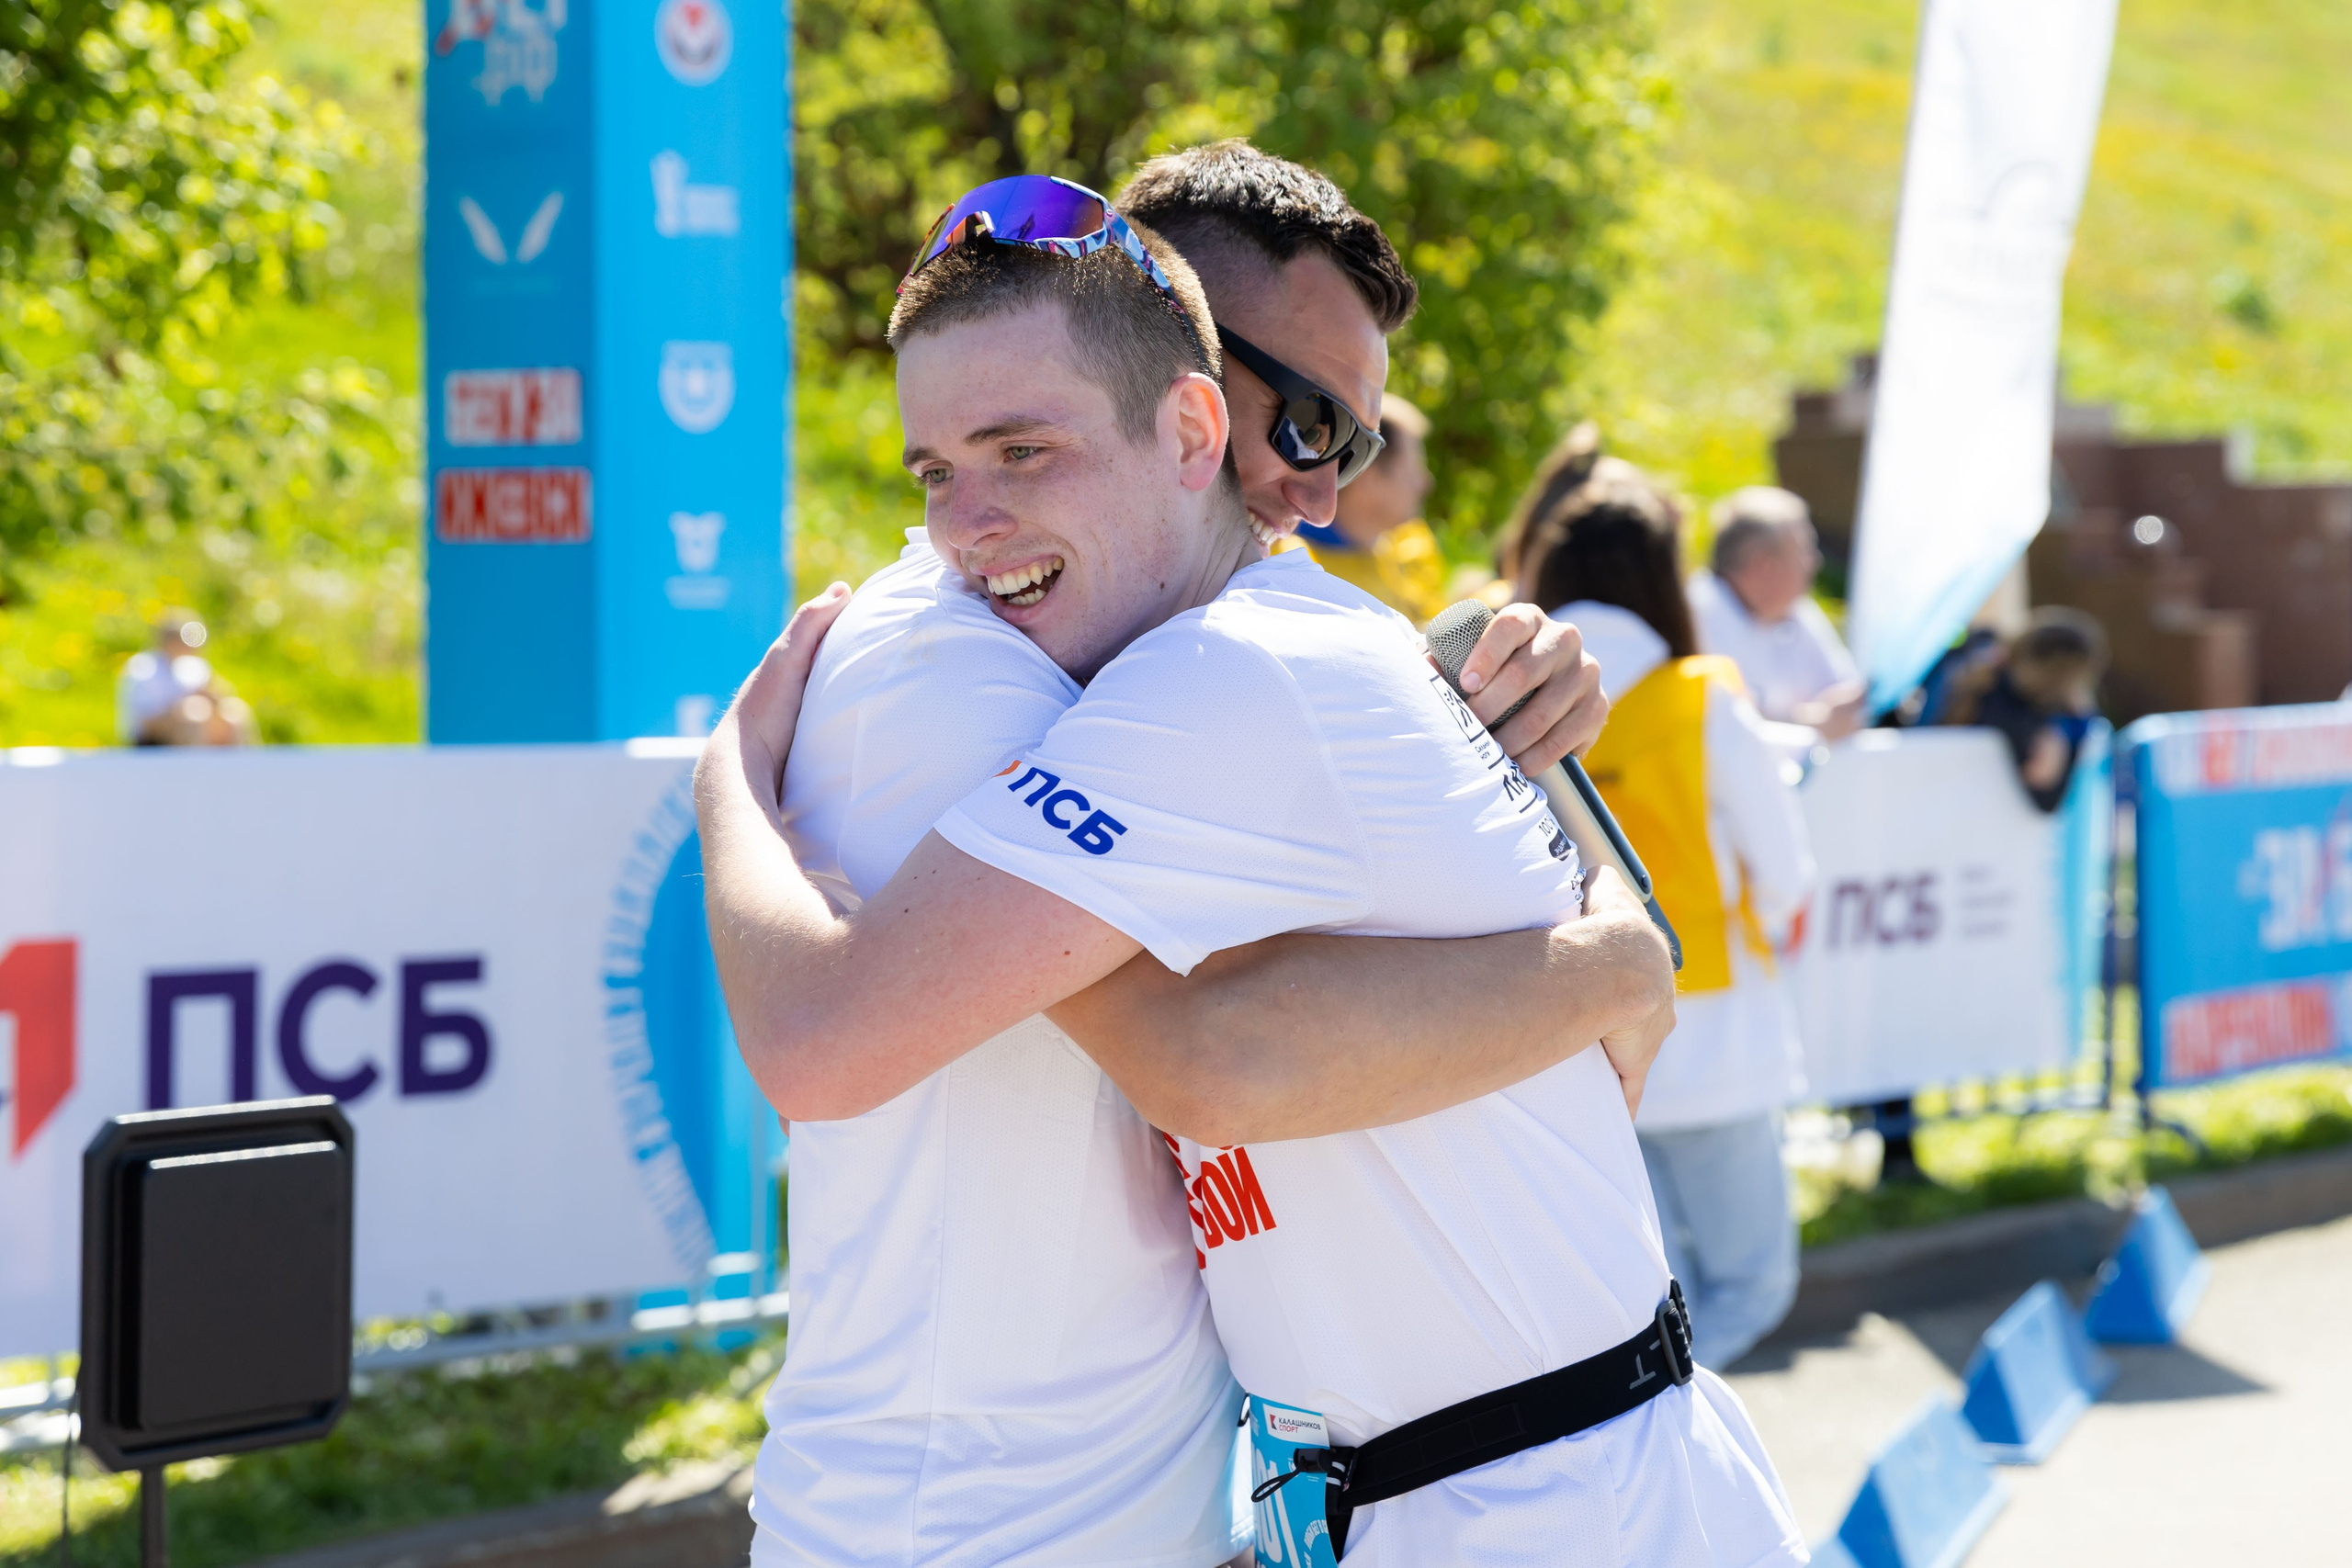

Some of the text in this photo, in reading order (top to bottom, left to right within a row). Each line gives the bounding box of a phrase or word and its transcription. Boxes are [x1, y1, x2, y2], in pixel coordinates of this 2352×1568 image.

[1007, 767, 1128, 855] ПСБ
[1825, 870, 1945, 955] ПСБ
[146, 955, 492, 1110] ПСБ
[1278, 1417, 1322, 1430] КАЛАШНИКОВ
[1278, 1424, 1299, 1433] СПОРТ
